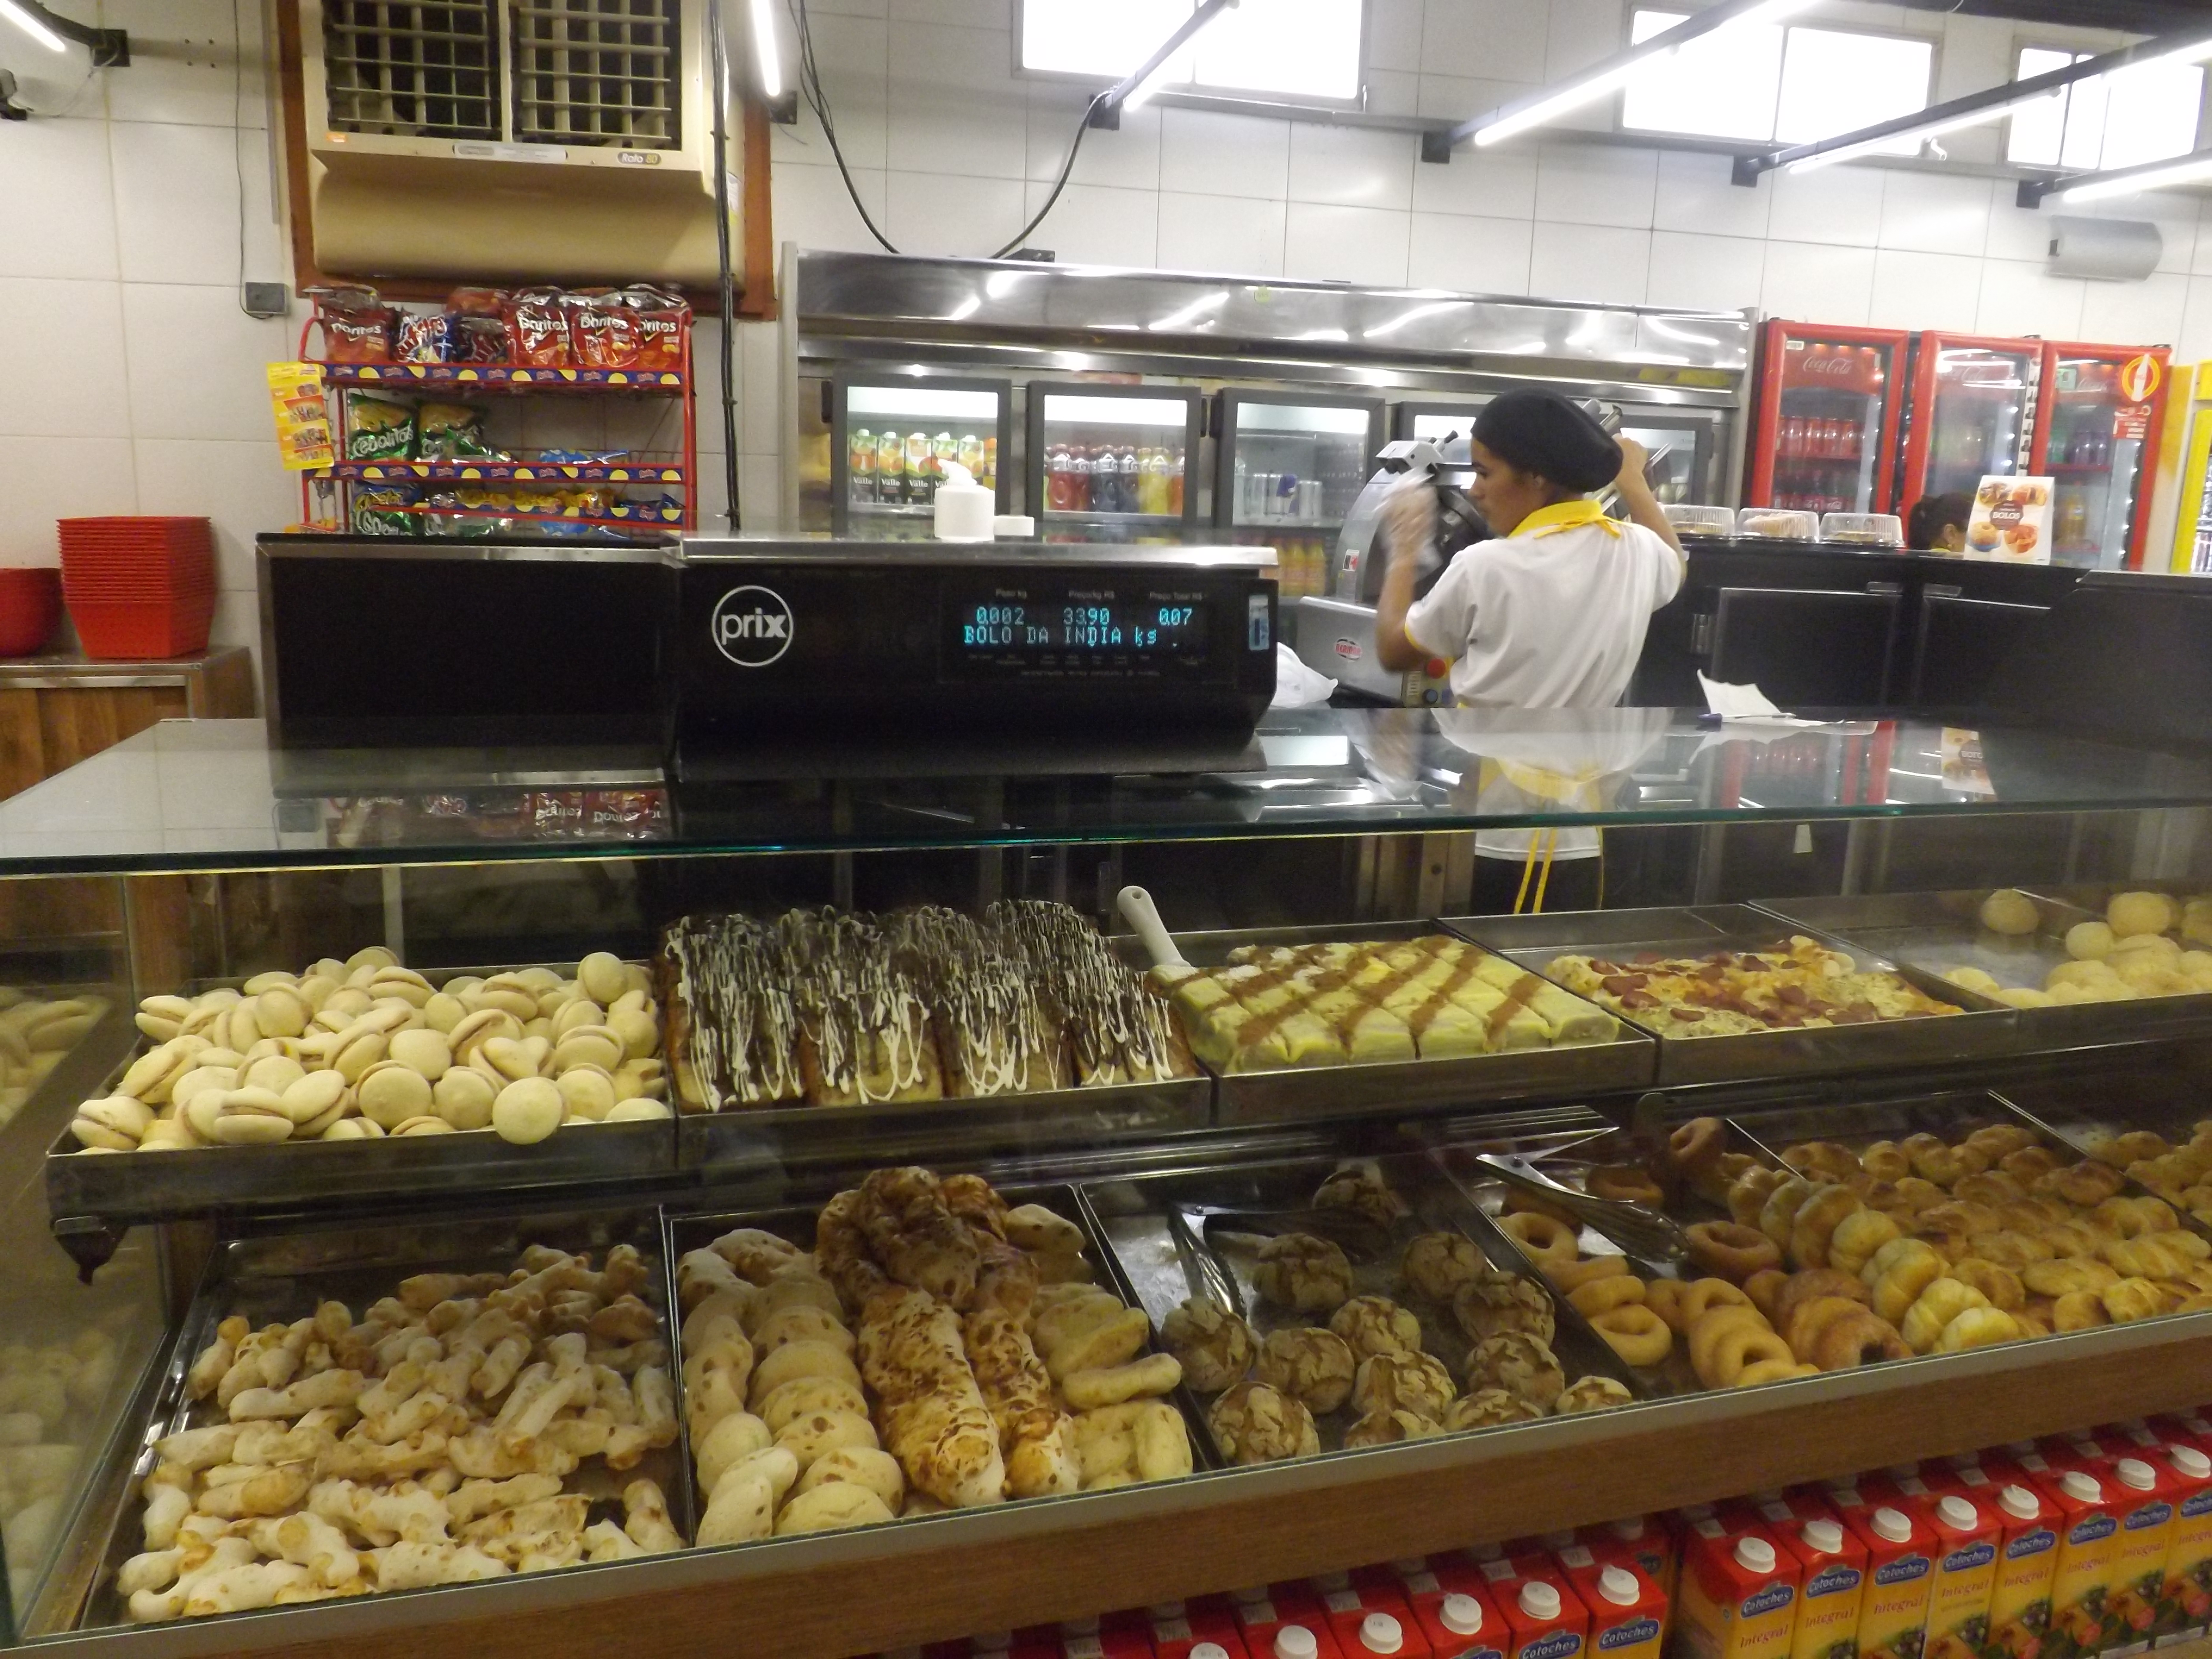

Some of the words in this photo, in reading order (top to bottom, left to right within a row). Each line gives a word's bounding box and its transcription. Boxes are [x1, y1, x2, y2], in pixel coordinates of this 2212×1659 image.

[331, 322, 382, 335] Doritos
[519, 318, 568, 332] Doritos
[580, 315, 628, 330] Doritos
[640, 320, 676, 333] oritos
[853, 476, 873, 484] Valle
[881, 478, 901, 486] Valle
[909, 479, 928, 487] Valle
[1992, 511, 2021, 519] BOLOS
[721, 607, 787, 645] prix
[964, 625, 1012, 644] BOLO
[1027, 626, 1049, 644] DA
[1064, 626, 1121, 646] INDIA
[1942, 1578, 1990, 1598] Integral
[1874, 1595, 1924, 1615] Integral
[1806, 1606, 1855, 1628] Integral
[1601, 1624, 1655, 1645] Cotoches
[1740, 1624, 1788, 1648] Integral
